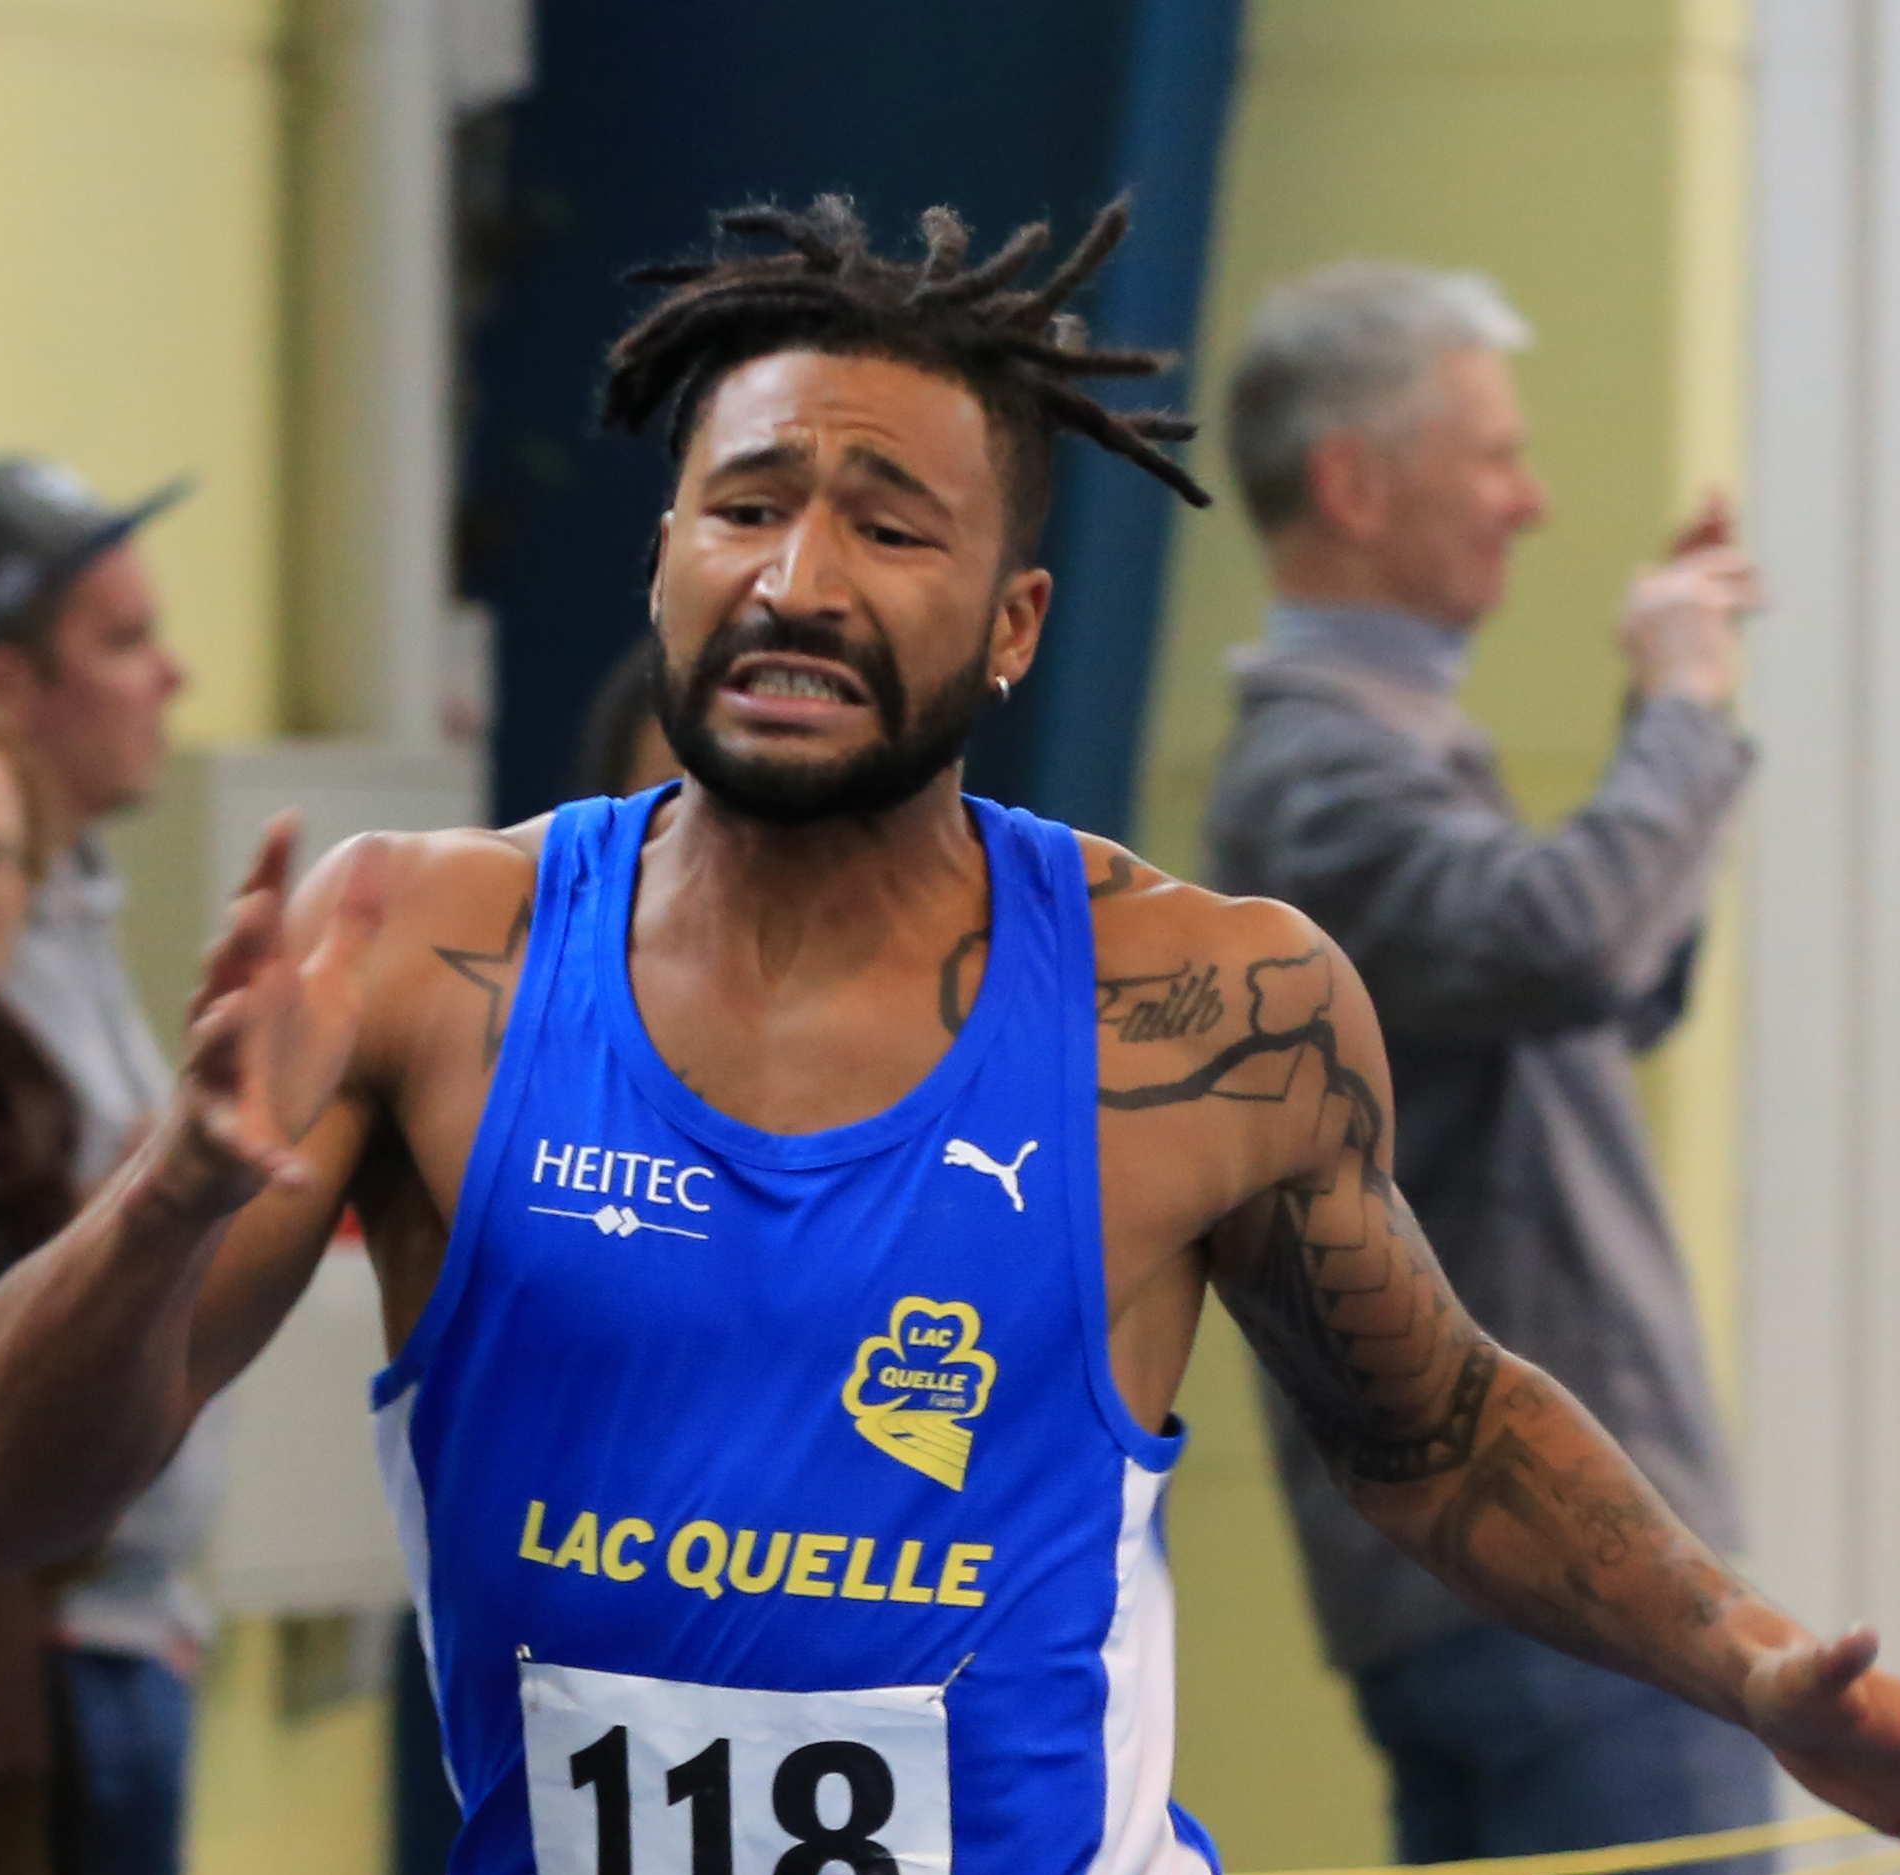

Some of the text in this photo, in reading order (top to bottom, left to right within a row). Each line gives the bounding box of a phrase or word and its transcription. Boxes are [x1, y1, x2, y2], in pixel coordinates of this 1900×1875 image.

[532, 1138, 715, 1213] HEITEC
[908, 1326, 954, 1348] LAC
[879, 1366, 968, 1392] QUELLE
[518, 1499, 994, 1607] LAC QUELLE
